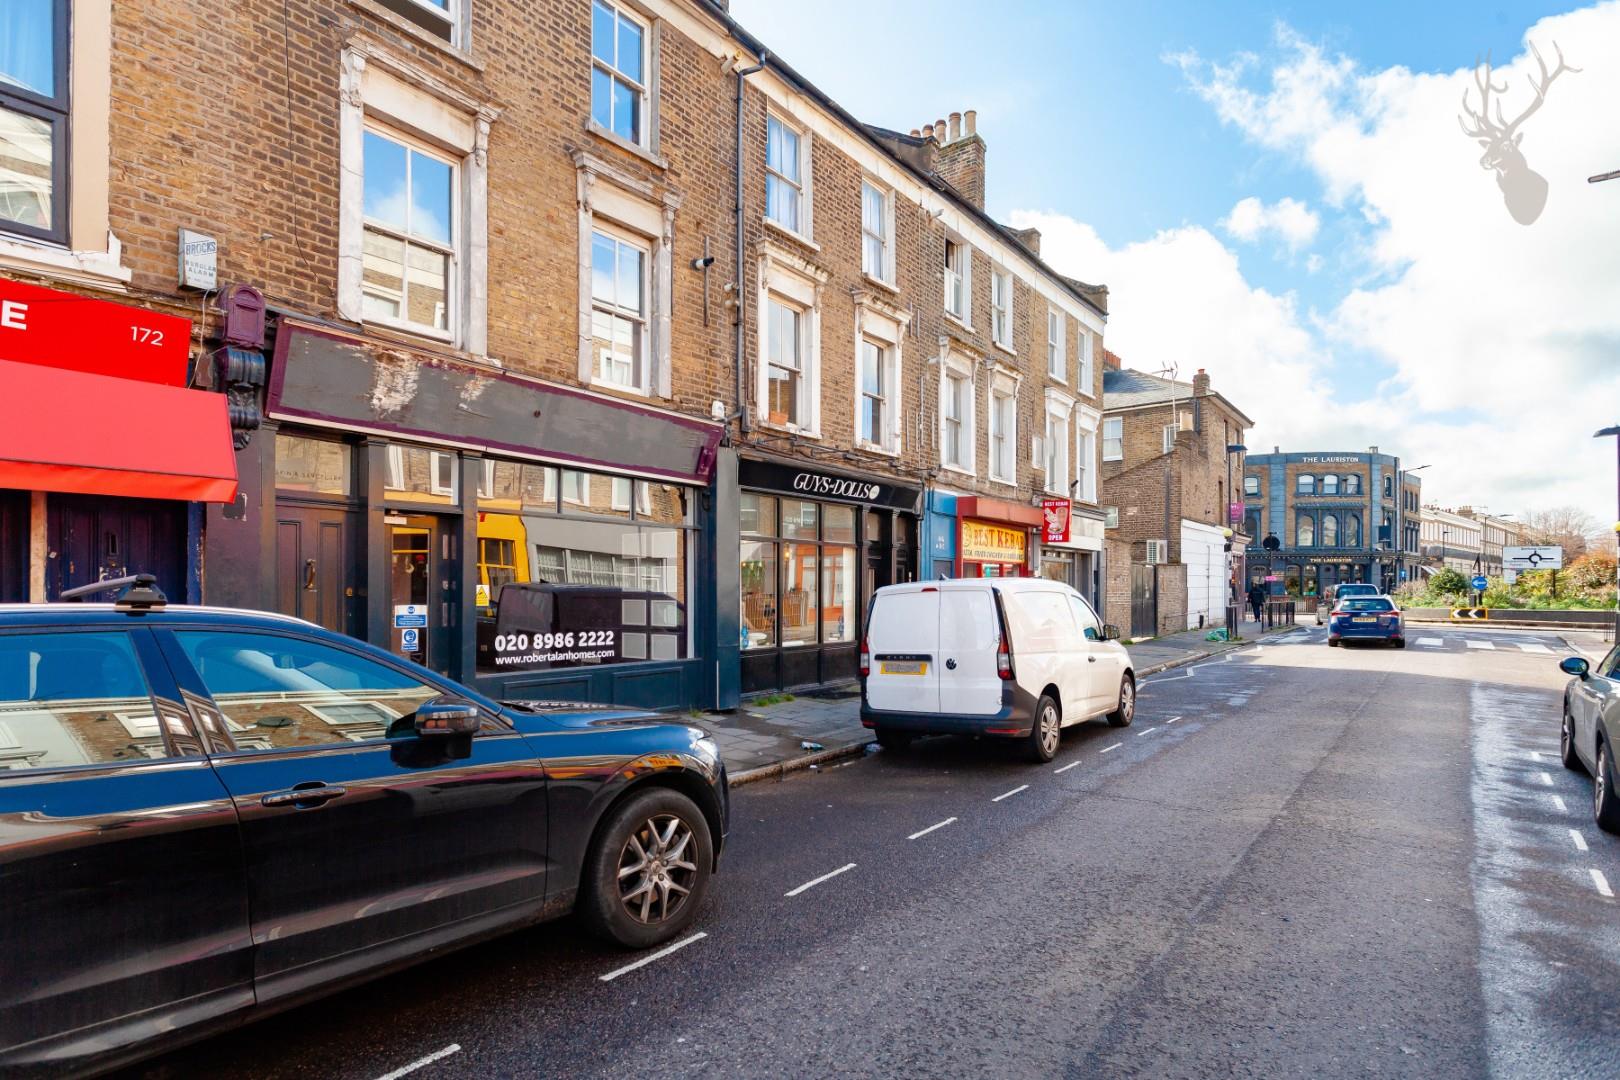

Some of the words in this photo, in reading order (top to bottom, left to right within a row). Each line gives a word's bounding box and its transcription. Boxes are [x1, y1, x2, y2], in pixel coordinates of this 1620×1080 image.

[130, 326, 163, 346] 172
[974, 529, 995, 547] BEST
[997, 529, 1024, 550] KEBAB
[494, 634, 529, 652] 020
[533, 632, 575, 650] 8986
[578, 630, 615, 647] 2222
[495, 649, 615, 665] www.robertalanhomes.com
